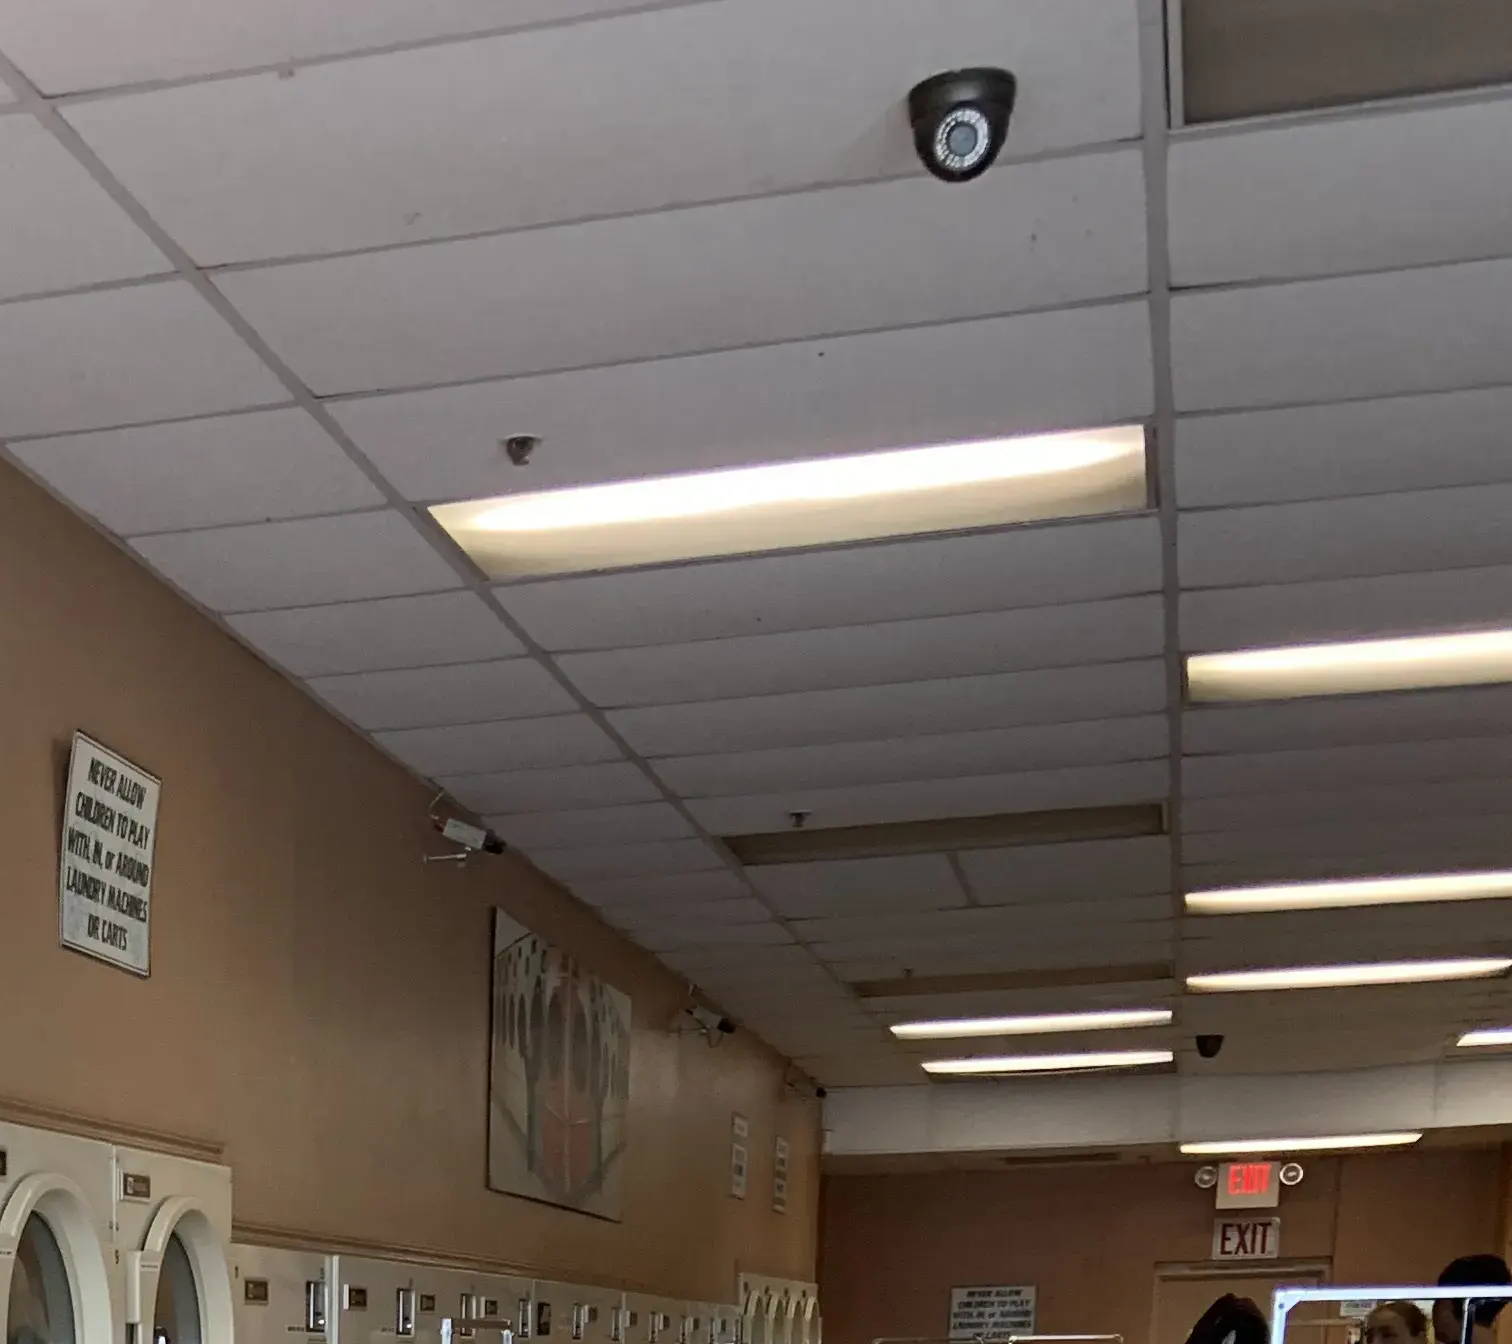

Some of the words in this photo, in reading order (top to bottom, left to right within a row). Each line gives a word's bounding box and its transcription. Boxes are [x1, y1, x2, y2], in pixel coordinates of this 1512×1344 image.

[88, 757, 117, 794] NEVER
[116, 774, 147, 810] ALLOW
[75, 791, 116, 833] CHILDREN
[116, 812, 129, 840] TO
[128, 818, 150, 850] PLAY
[116, 852, 149, 887] AROUND
[66, 866, 107, 905] LAUNDRY
[107, 884, 147, 922] MACHINES
[88, 913, 100, 940] OR
[102, 919, 128, 951] CARTS
[1228, 1163, 1272, 1195] EXIT
[1220, 1222, 1272, 1255] EXIT
